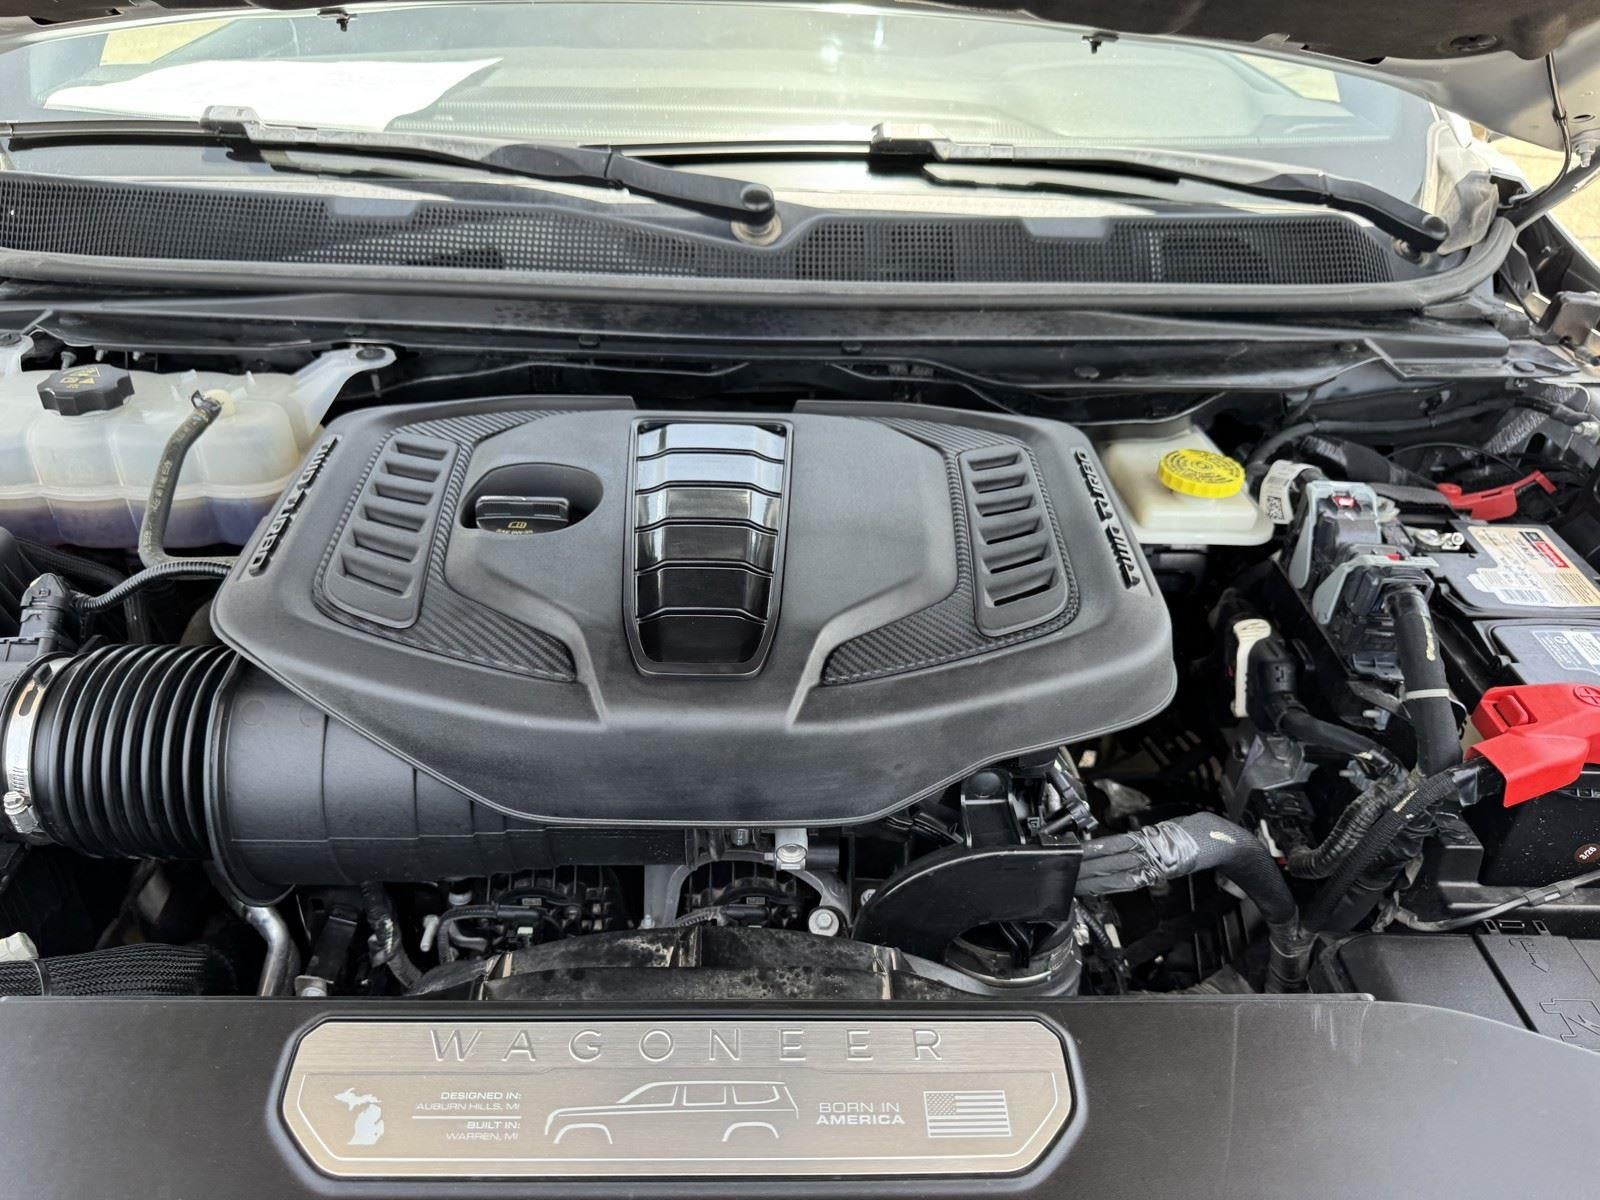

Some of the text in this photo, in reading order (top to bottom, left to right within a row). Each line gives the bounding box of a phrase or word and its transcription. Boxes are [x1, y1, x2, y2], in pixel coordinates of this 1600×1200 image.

[430, 1028, 943, 1063] WAGONEER
[440, 1091, 522, 1100] DESIGNED IN:
[415, 1102, 467, 1111] AUBURN
[505, 1102, 520, 1111] MI
[819, 1102, 900, 1113] BORN IN
[816, 1114, 905, 1125] AMERICA
[466, 1121, 520, 1130] BUILT IN:
[504, 1132, 519, 1140] MI
